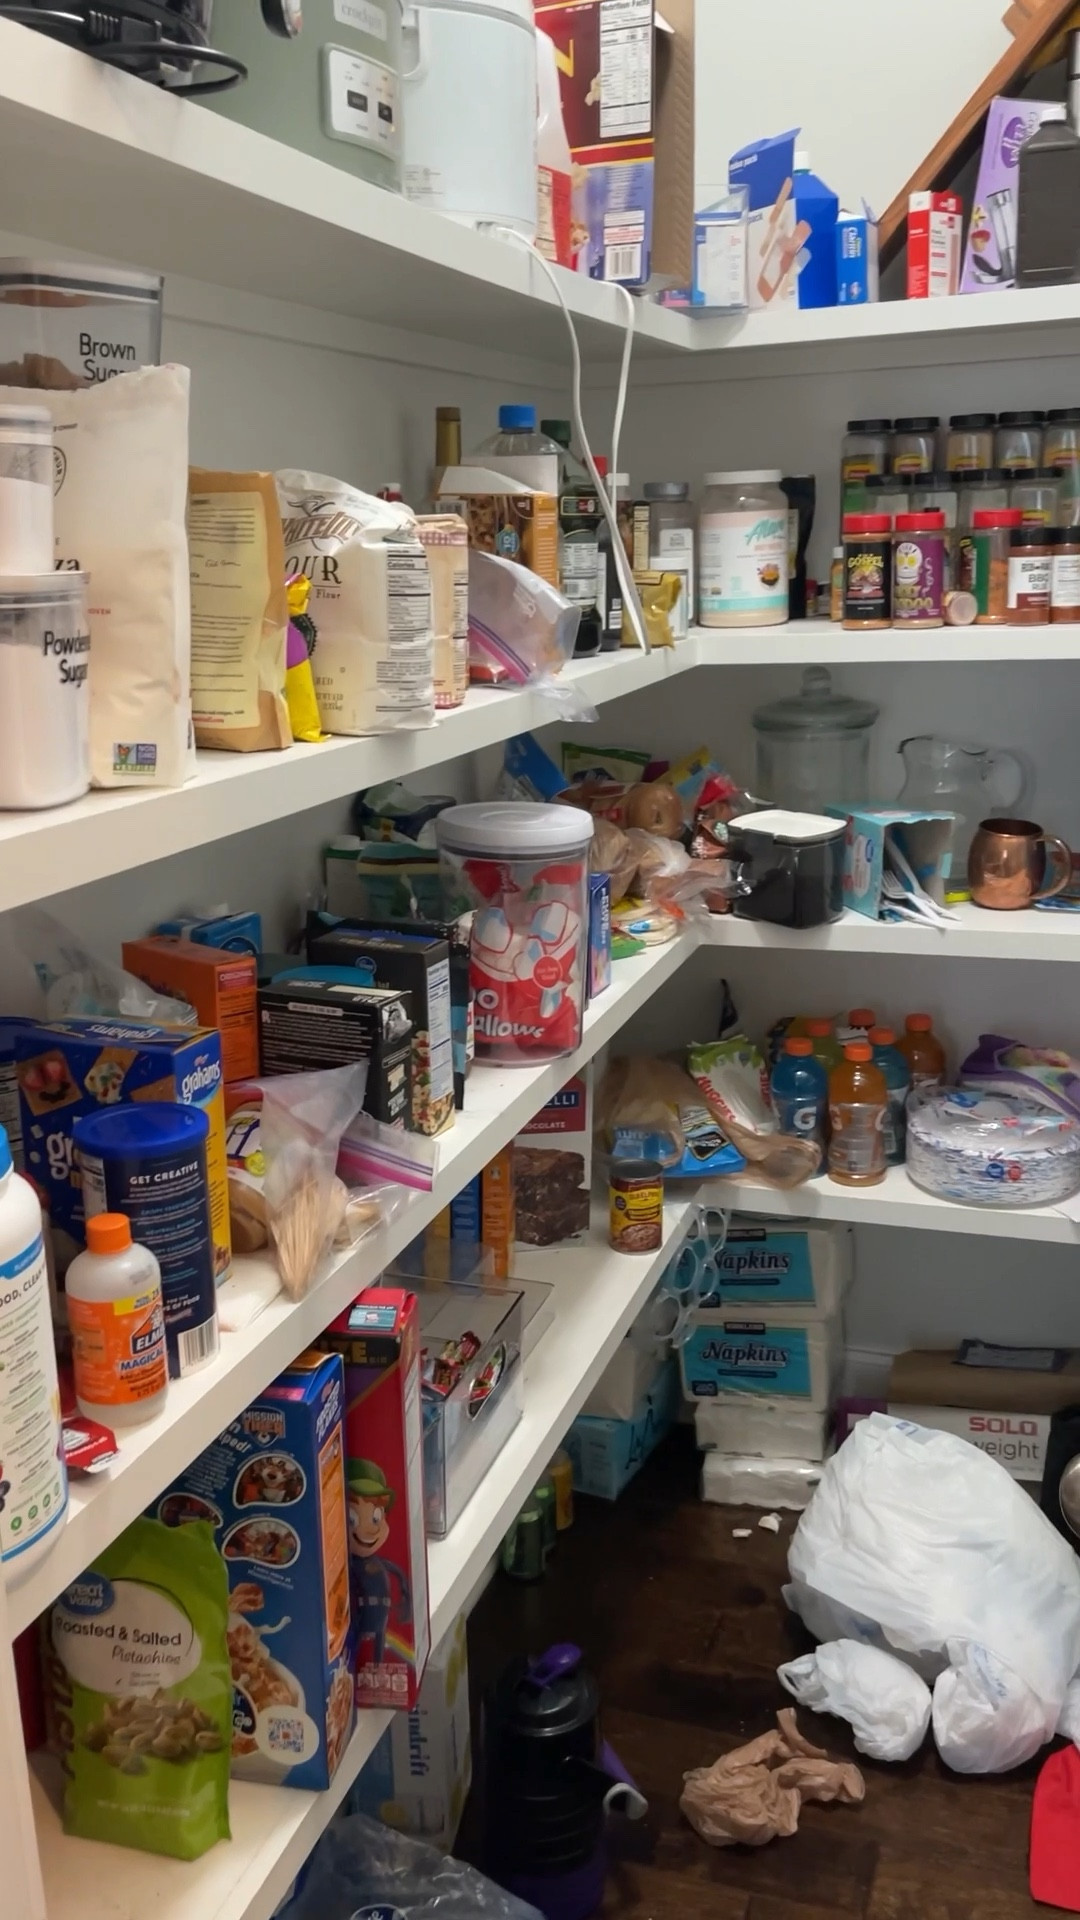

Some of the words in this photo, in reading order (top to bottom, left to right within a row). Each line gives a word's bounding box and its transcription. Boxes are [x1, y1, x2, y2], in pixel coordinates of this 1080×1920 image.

[79, 333, 136, 361] Brown
[84, 359, 131, 381] Sug
[285, 555, 342, 584] OUR
[848, 556, 884, 568] GOSPEL
[316, 589, 341, 600] Flour
[474, 1014, 545, 1039] allows
[181, 1059, 221, 1105] grahams
[526, 1121, 567, 1130] OCOLATE
[793, 1106, 817, 1131] G
[129, 1175, 151, 1185] GET
[154, 1161, 199, 1183] CREATIVE
[714, 1249, 791, 1275] Napkins
[702, 1340, 790, 1366] Napkins
[243, 1411, 284, 1422] MISSION
[969, 1416, 1038, 1436] SOLO
[67, 1583, 104, 1598] reat
[70, 1596, 104, 1607] Value
[55, 1617, 115, 1639] Roasted
[118, 1626, 128, 1641] &
[132, 1628, 182, 1646] Salted
[111, 1645, 181, 1665] Pistachios
[408, 1704, 430, 1777] indrift
